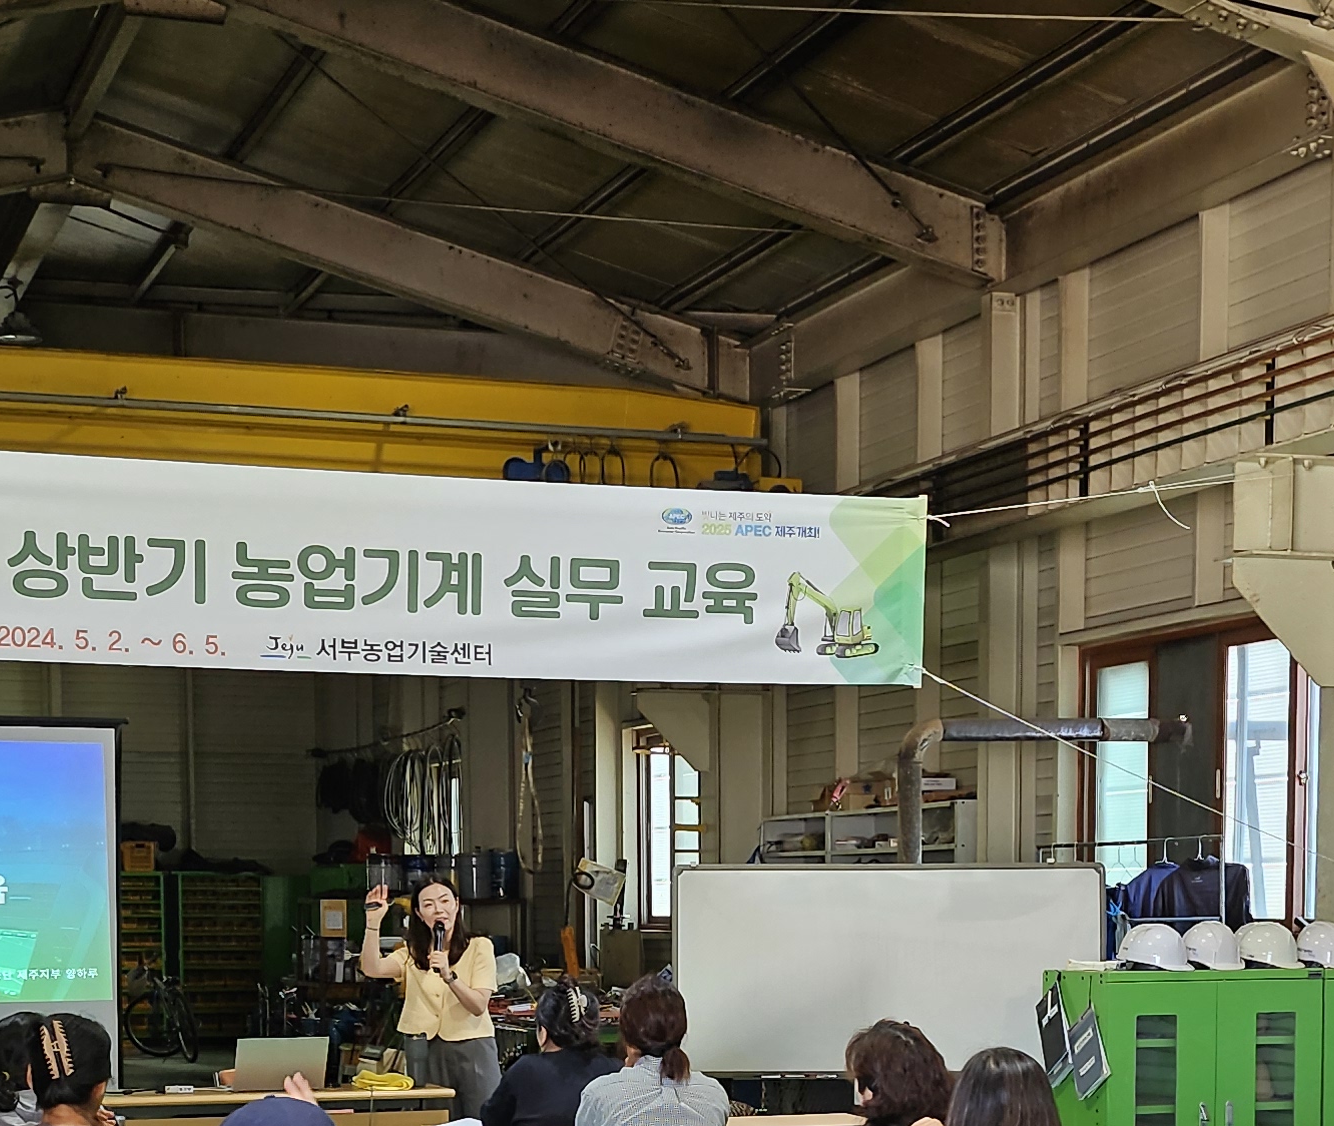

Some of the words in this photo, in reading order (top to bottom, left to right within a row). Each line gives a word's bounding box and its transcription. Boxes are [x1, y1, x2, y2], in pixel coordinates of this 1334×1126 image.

[728, 511, 754, 522] 제주의
[701, 523, 732, 535] 2025
[734, 524, 772, 537] APEC
[774, 525, 820, 539] 제주개최!
[6, 529, 207, 605] 상반기
[231, 540, 483, 616] 농업기계
[503, 553, 624, 622] 실무
[641, 560, 758, 625] 교육
[74, 630, 98, 653] 5.
[107, 630, 130, 654] 2.
[172, 632, 195, 656] 6.
[205, 634, 227, 658] 5.
[266, 635, 305, 660] Jeju
[316, 637, 493, 666] 서부농업기술센터
[17, 968, 61, 981] 제주지부
